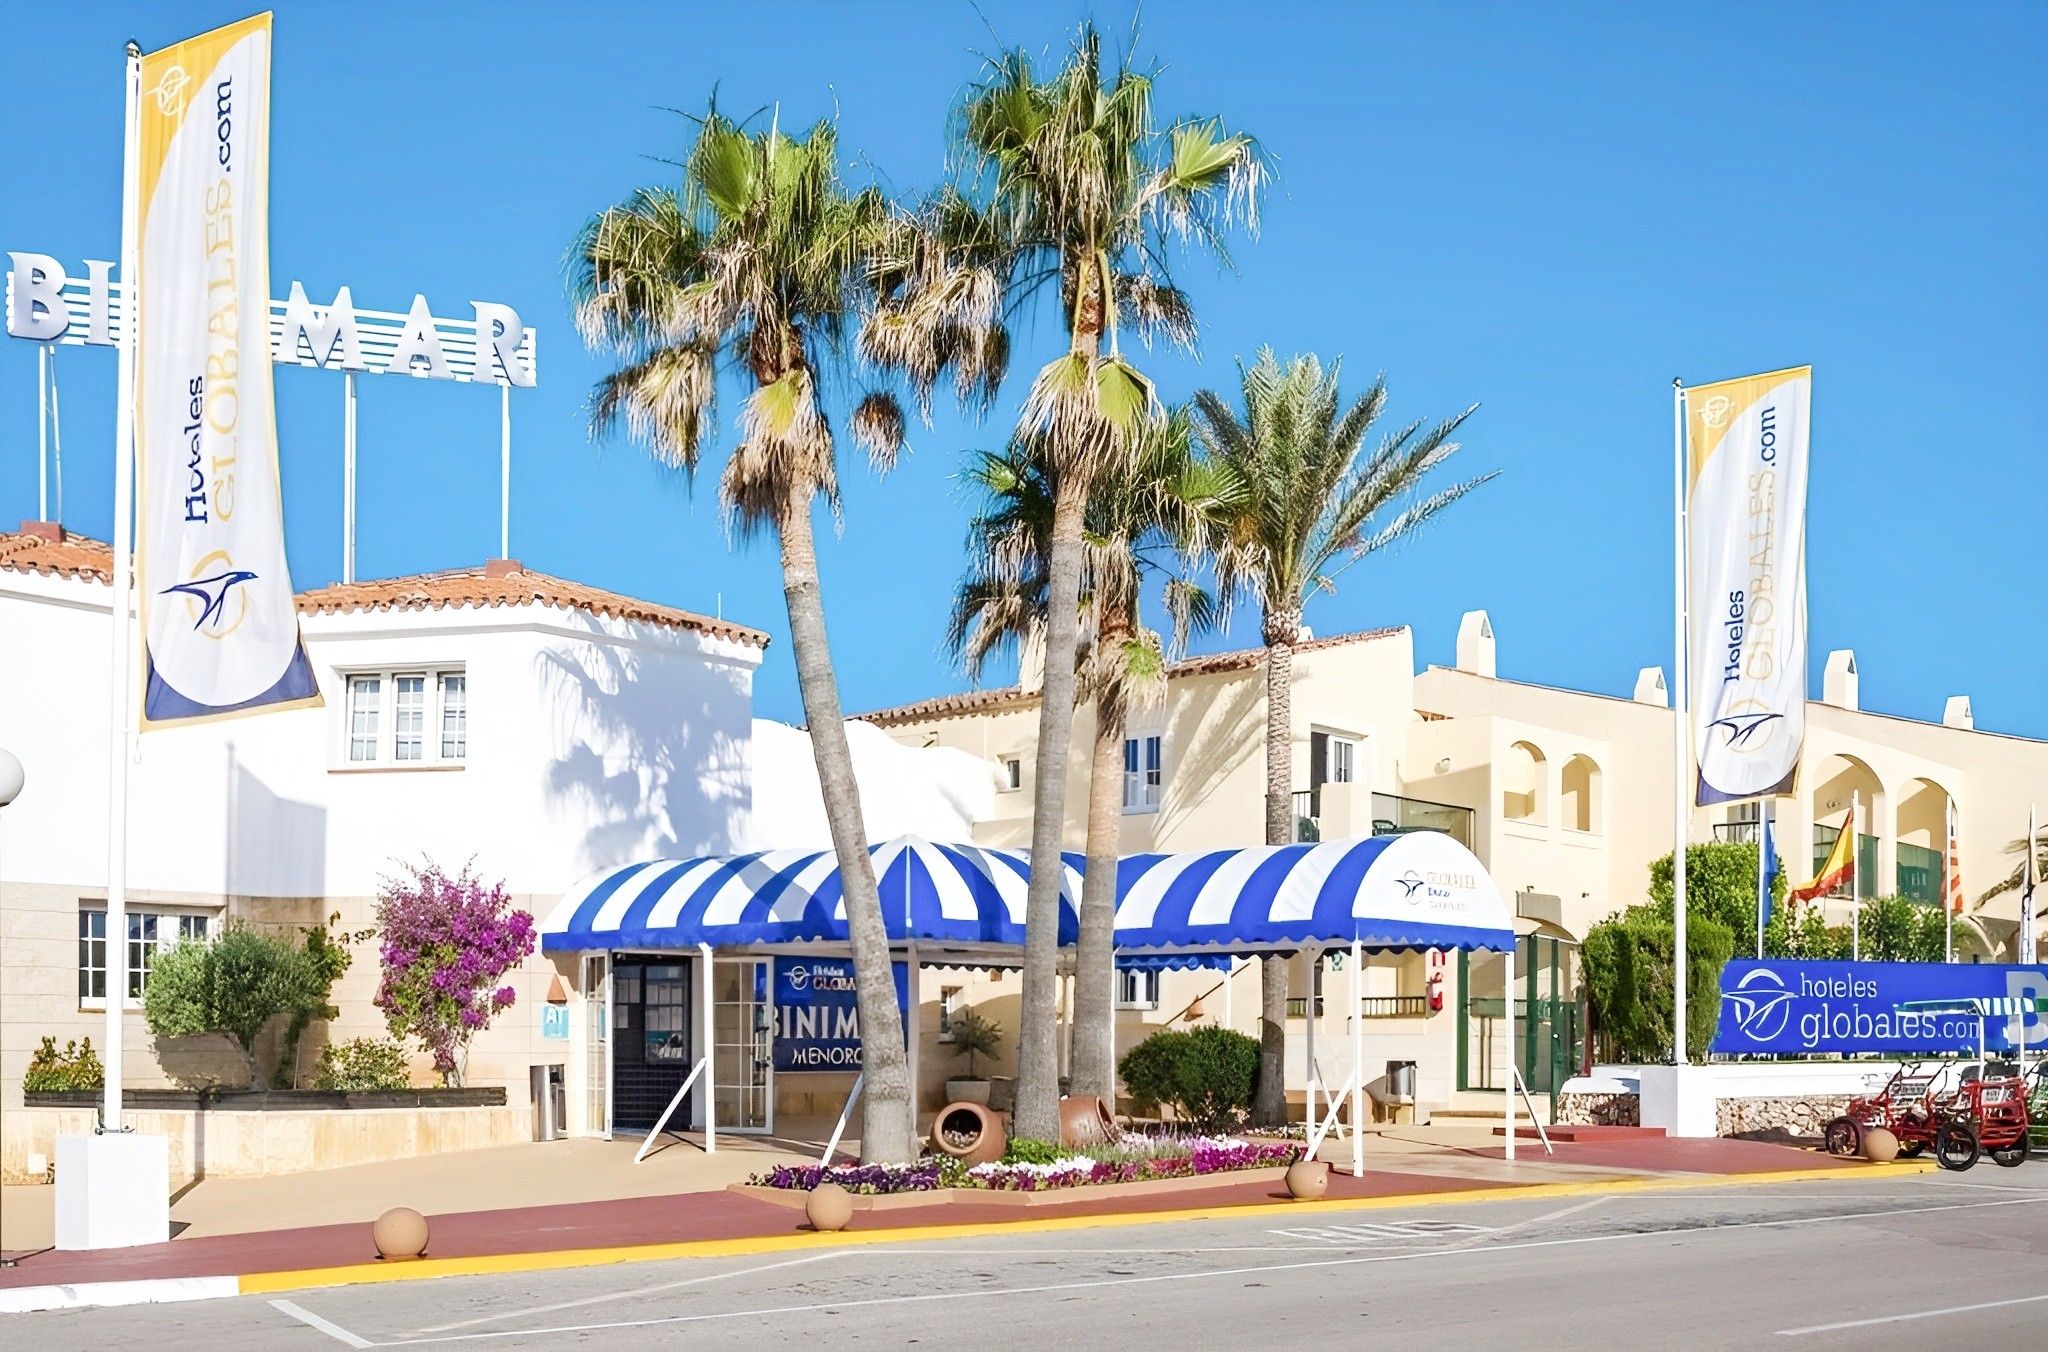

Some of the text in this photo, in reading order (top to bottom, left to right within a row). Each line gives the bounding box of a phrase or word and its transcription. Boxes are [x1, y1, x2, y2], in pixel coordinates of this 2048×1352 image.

[185, 376, 208, 523] Hoteles
[1723, 590, 1745, 684] Hoteles
[1801, 972, 1877, 998] hoteles
